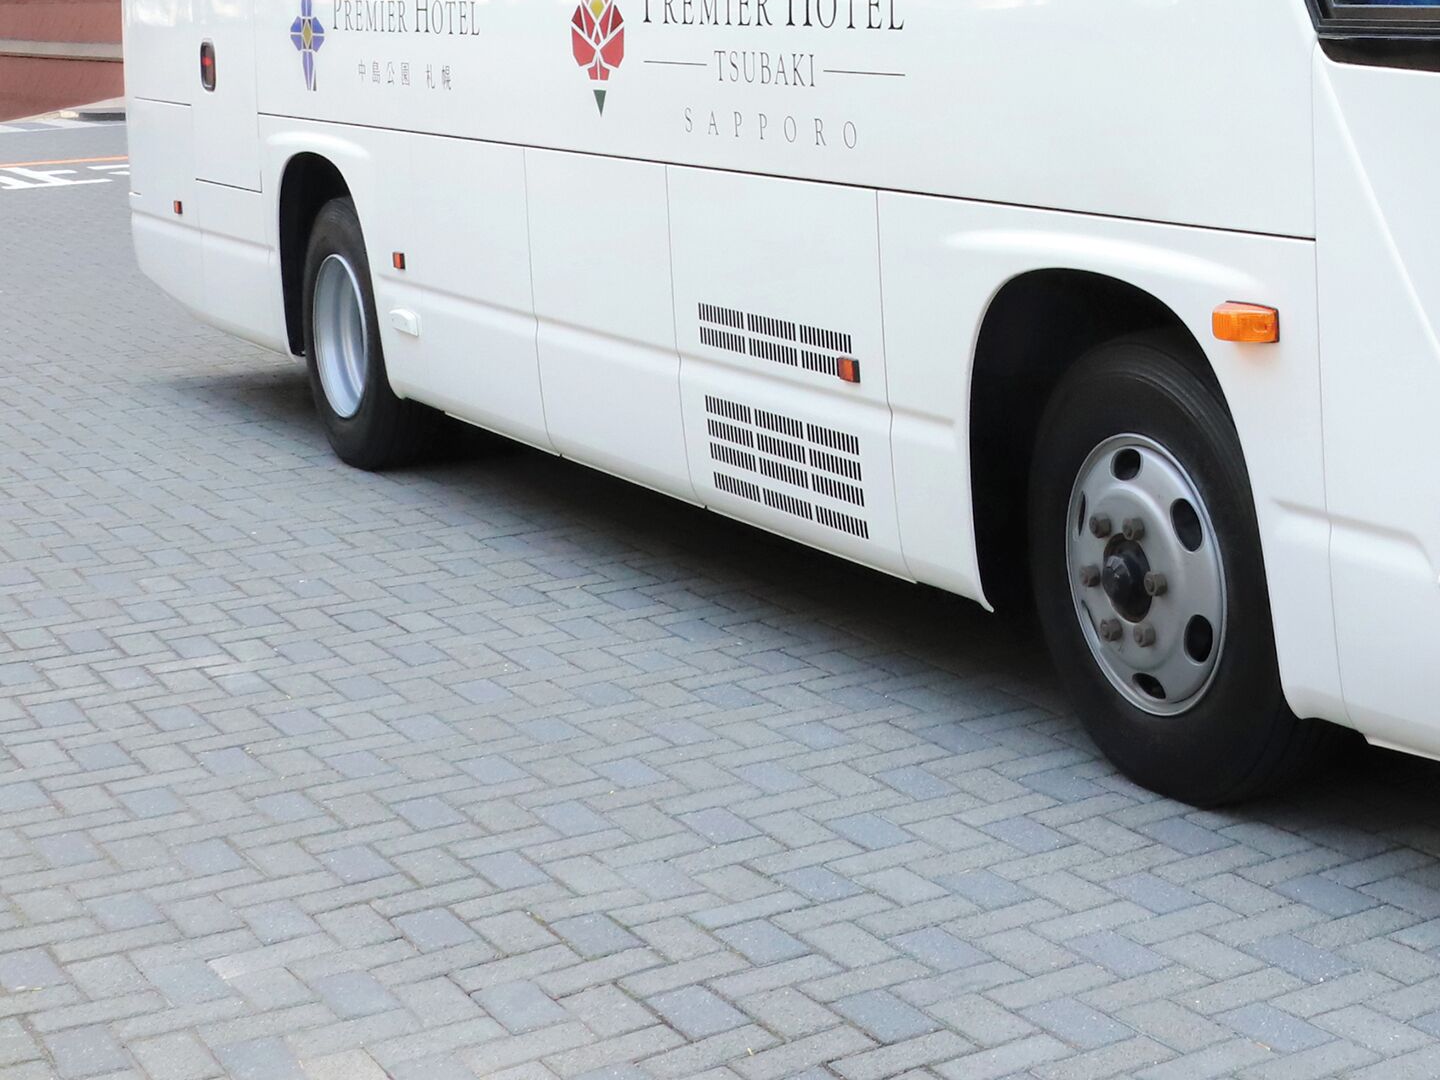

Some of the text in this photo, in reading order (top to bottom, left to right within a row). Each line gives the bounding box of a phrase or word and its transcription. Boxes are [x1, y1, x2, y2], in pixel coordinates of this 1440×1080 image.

[358, 59, 411, 86] 中島公園
[713, 50, 816, 87] TSUBAKI
[684, 107, 857, 149] SAPPORO
